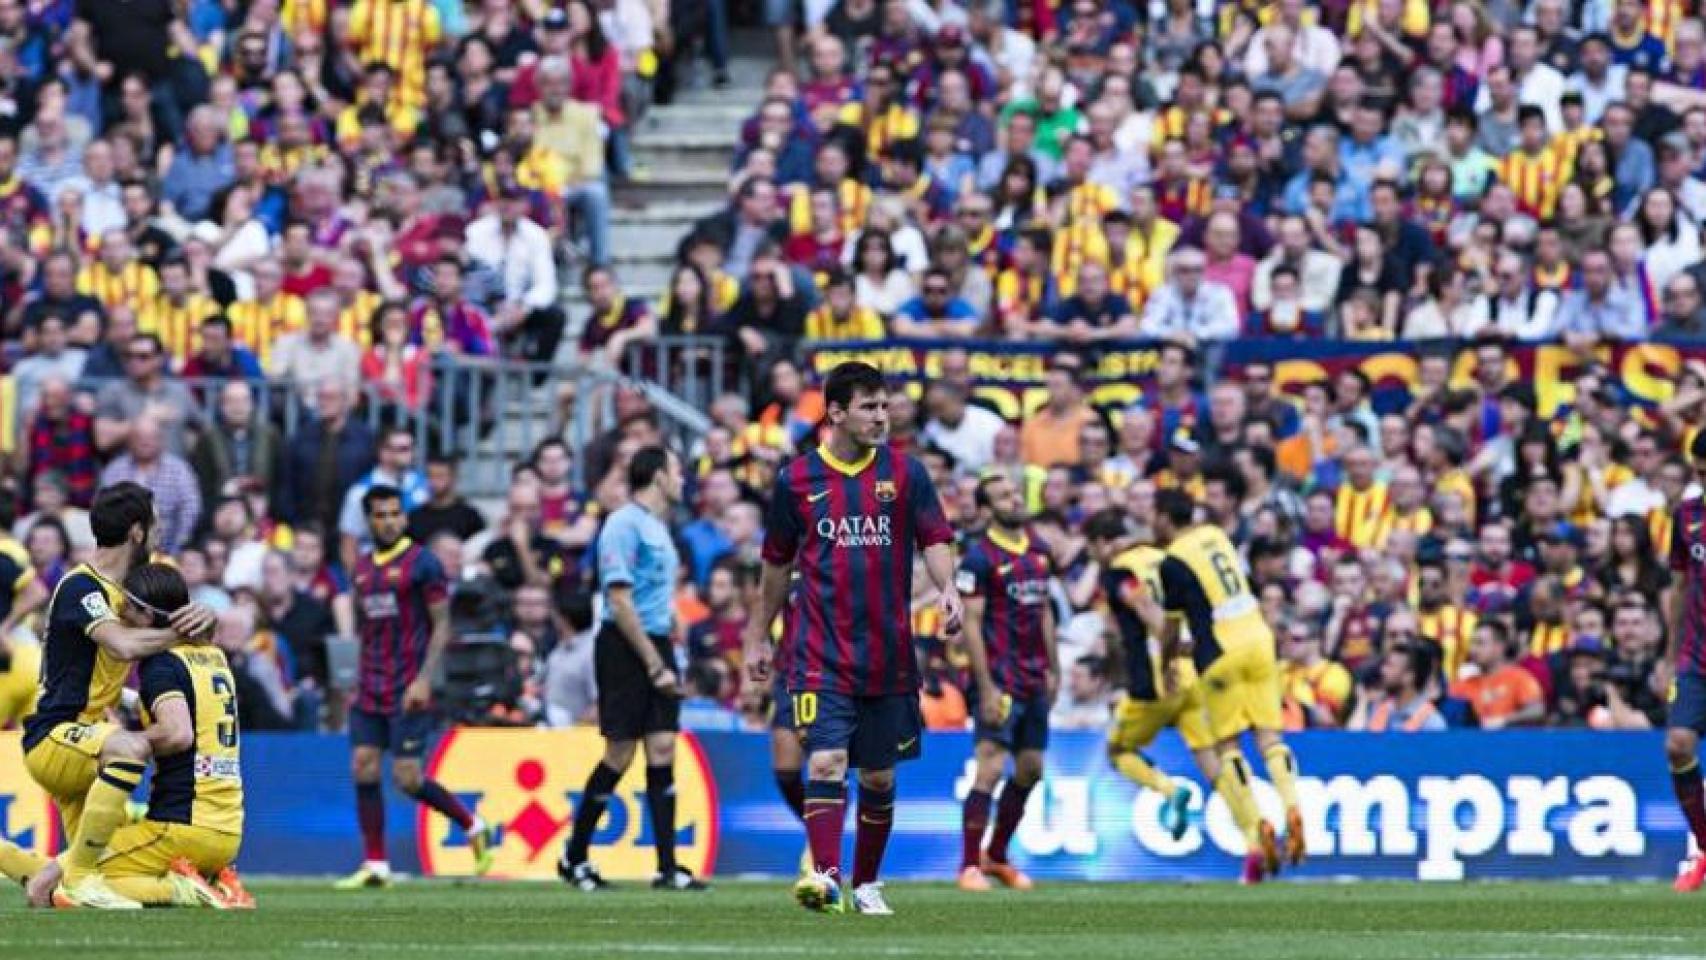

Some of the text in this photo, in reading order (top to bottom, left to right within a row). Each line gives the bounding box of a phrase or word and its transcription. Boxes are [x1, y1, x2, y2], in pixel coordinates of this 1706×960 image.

[817, 515, 890, 539] QATAR
[836, 535, 893, 548] AIRWAYS
[1212, 552, 1241, 597] 6
[212, 672, 237, 748] 3
[792, 693, 818, 727] 10
[1132, 774, 1645, 881] compra
